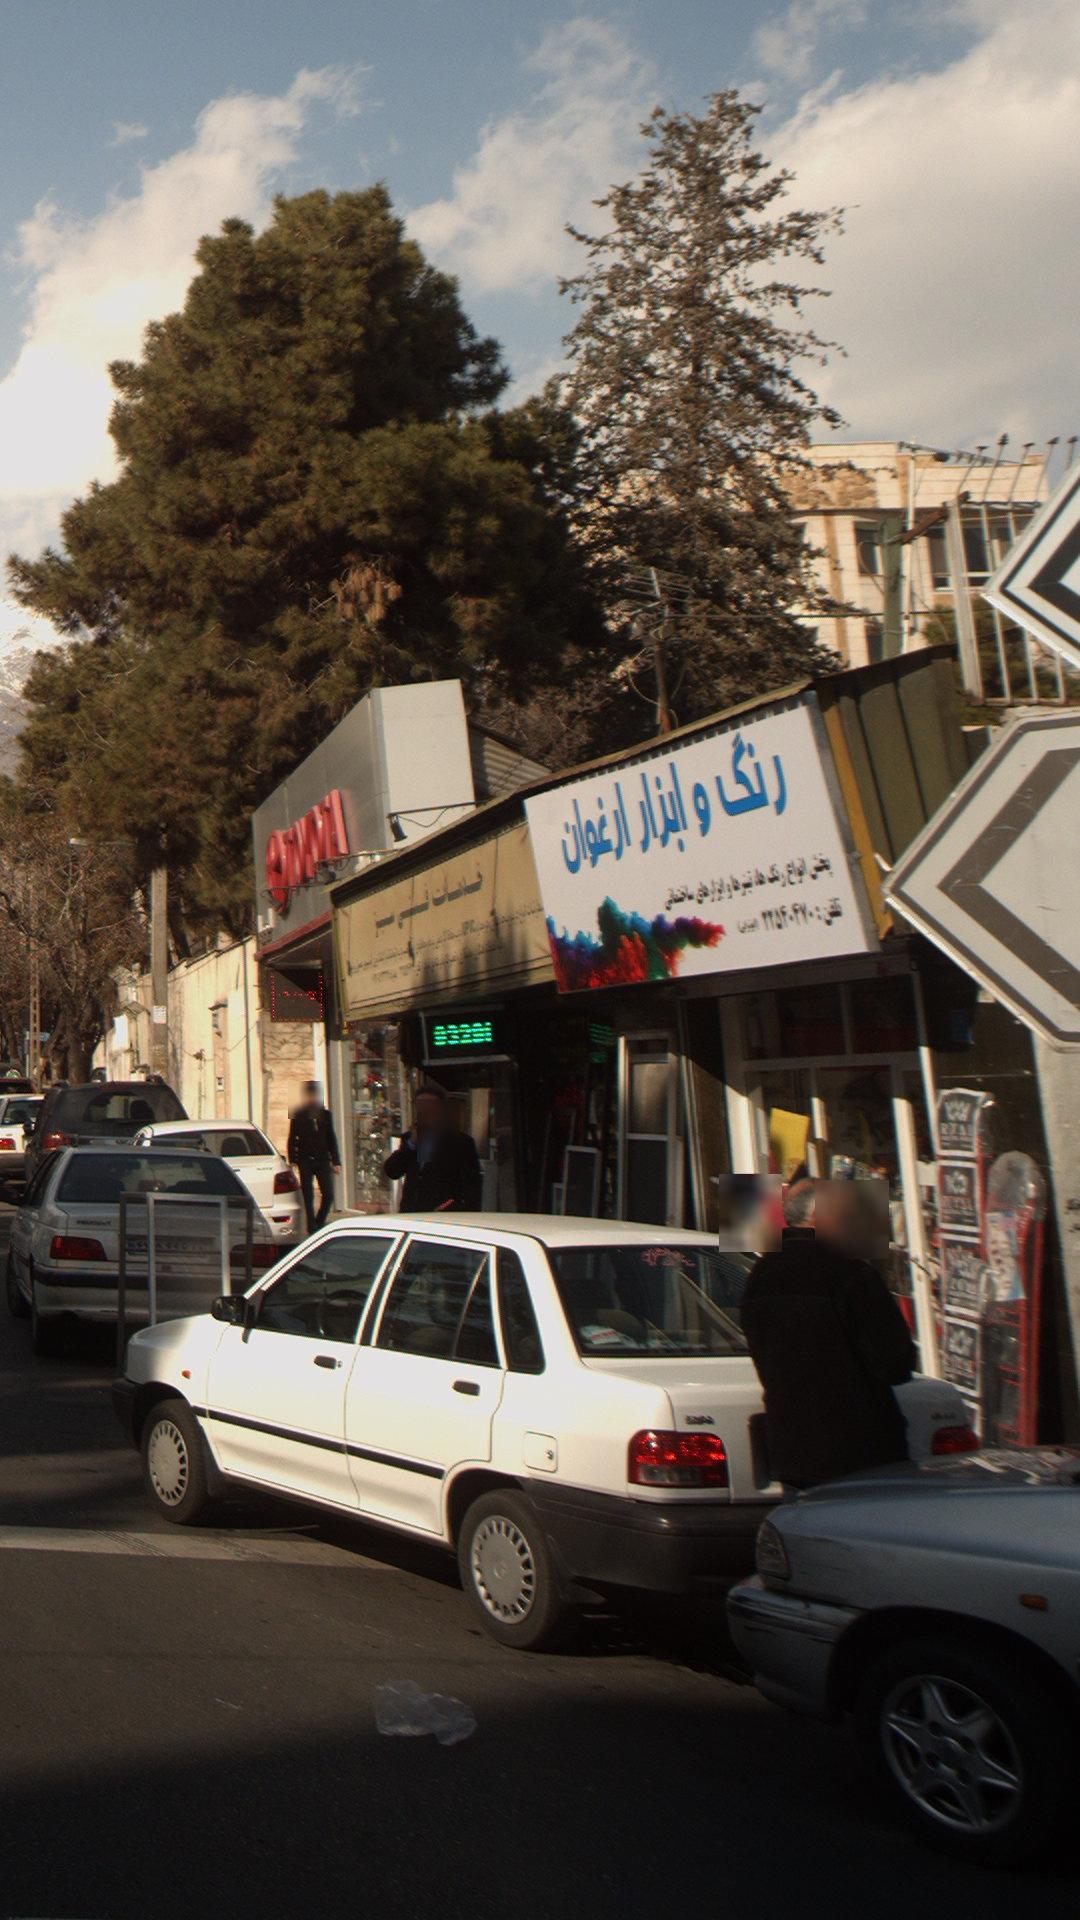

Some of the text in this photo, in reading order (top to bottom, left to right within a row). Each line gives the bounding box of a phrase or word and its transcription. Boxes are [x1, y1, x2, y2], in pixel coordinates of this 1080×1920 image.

[562, 732, 788, 874] رنگ و ابزار ارغوان
